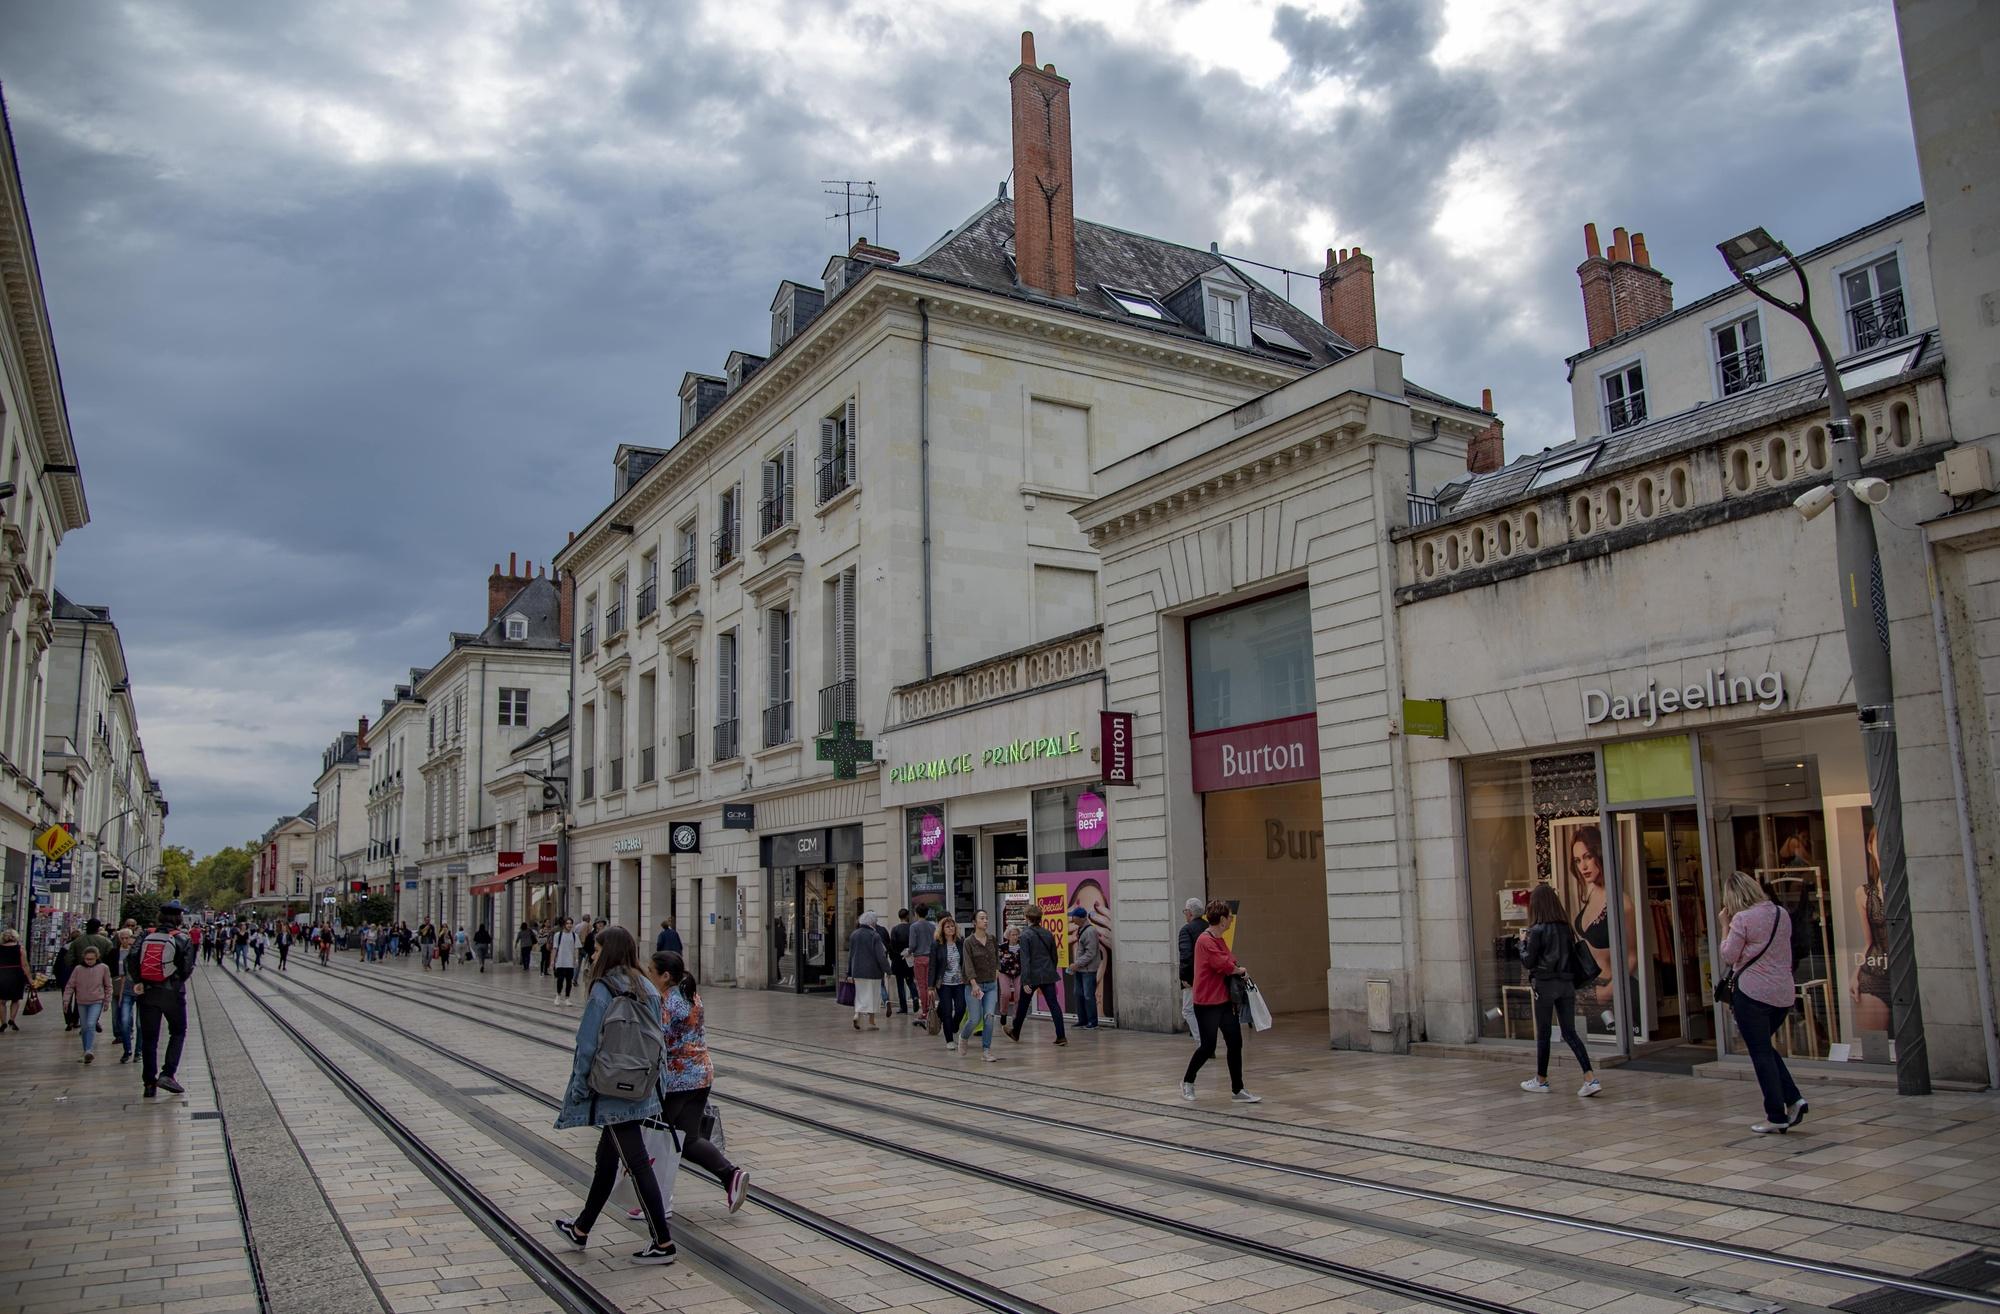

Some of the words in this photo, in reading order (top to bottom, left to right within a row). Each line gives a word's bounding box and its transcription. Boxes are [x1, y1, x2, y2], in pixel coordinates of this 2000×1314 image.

[1583, 666, 1784, 727] Darjeeling
[889, 753, 974, 784] PHARMACIE
[982, 731, 1083, 768] PRINCIPALE
[1111, 718, 1126, 780] Burton
[1222, 742, 1304, 777] Burton
[798, 838, 817, 852] GDM
